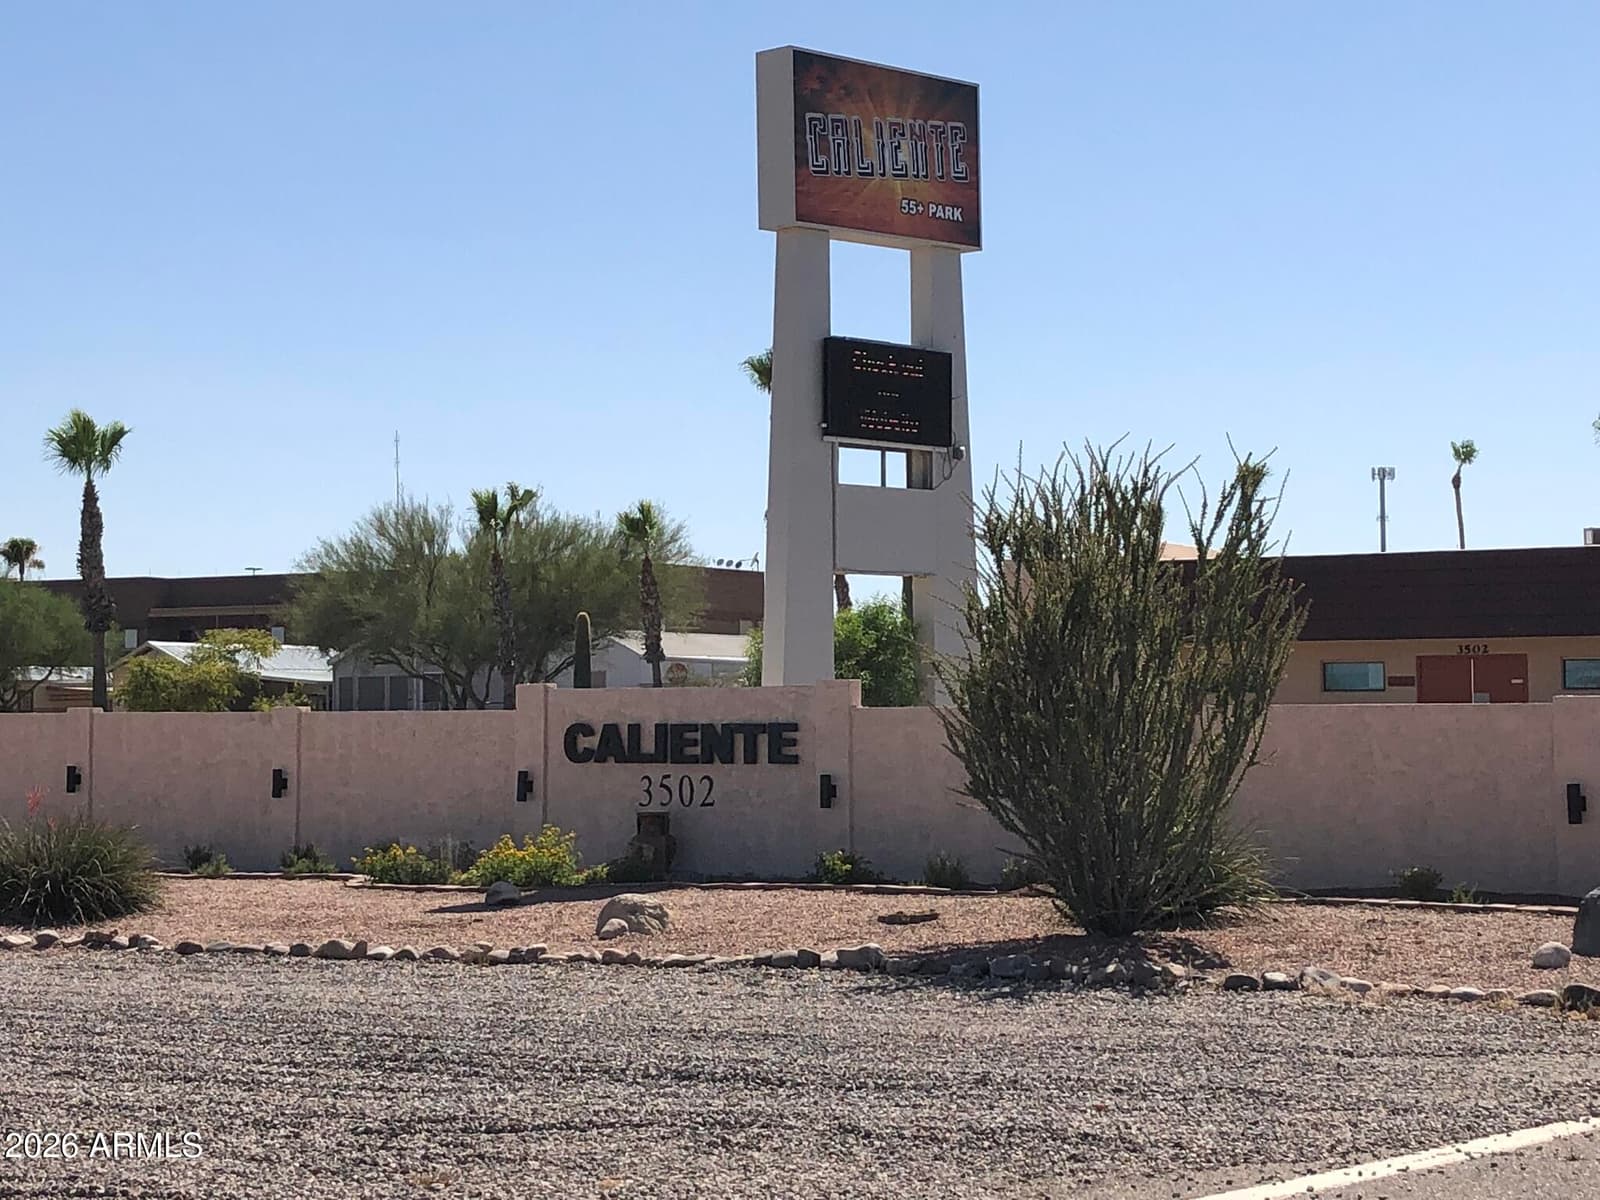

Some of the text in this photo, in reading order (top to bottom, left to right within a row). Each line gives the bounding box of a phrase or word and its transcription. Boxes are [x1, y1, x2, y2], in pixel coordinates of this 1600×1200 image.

[805, 112, 970, 183] CALIENTE
[901, 199, 963, 222] 55+ PARK
[1456, 644, 1489, 655] 3502
[563, 722, 800, 765] CALIENTE
[638, 774, 716, 808] 3502
